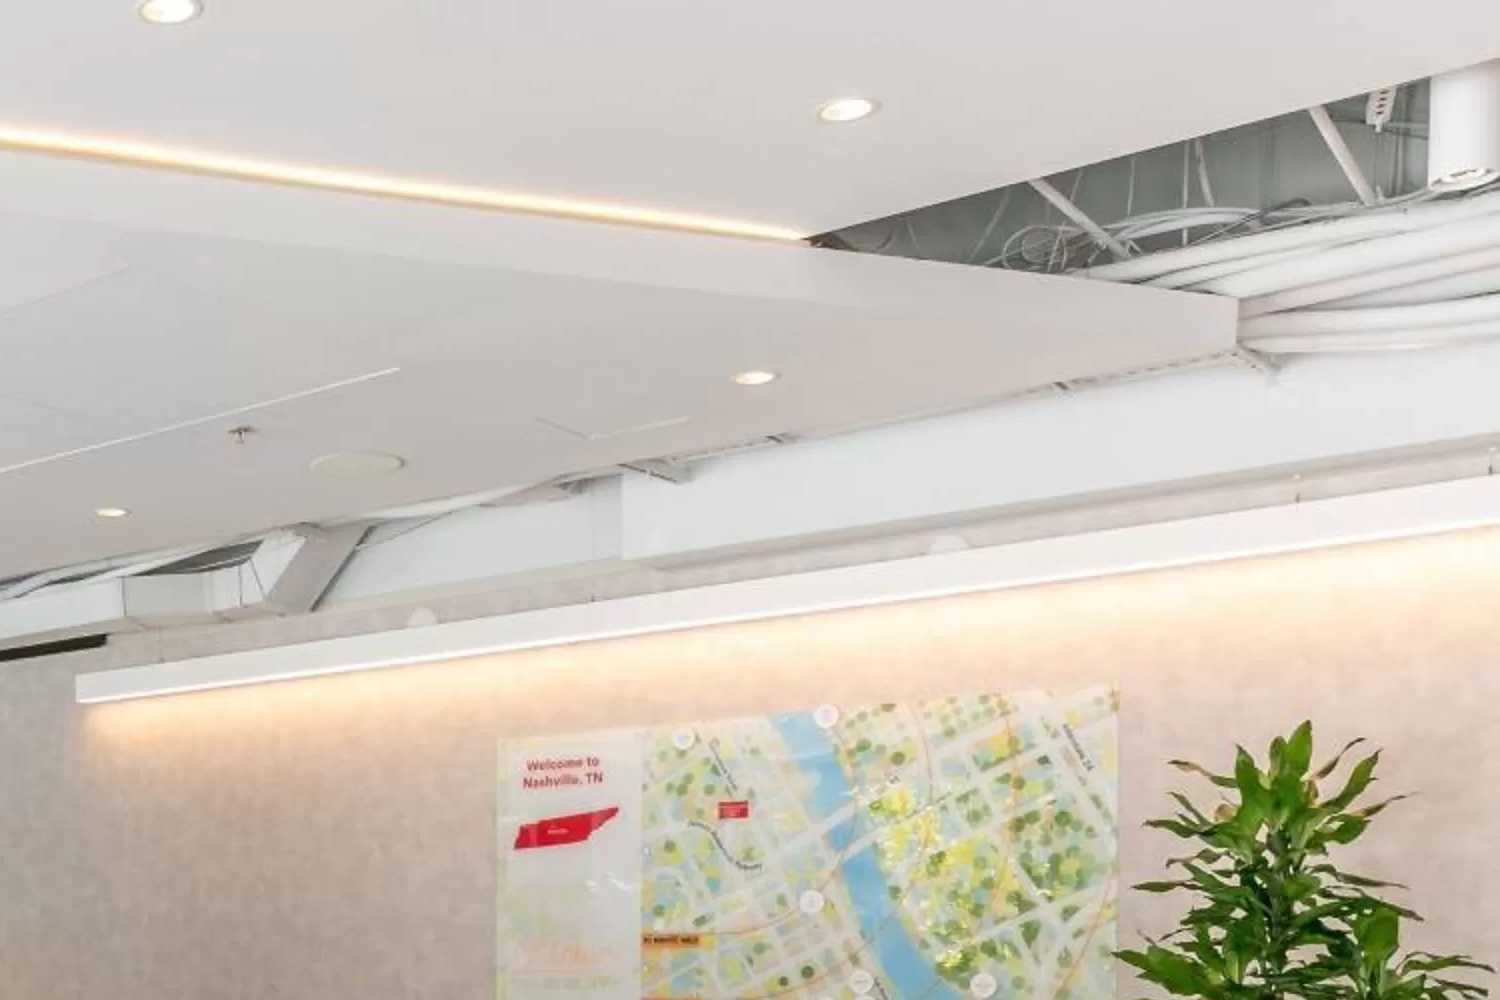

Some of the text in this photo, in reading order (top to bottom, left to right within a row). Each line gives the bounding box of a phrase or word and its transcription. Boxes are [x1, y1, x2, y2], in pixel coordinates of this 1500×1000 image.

[526, 756, 599, 771] Welcome to
[586, 771, 603, 784] TN
